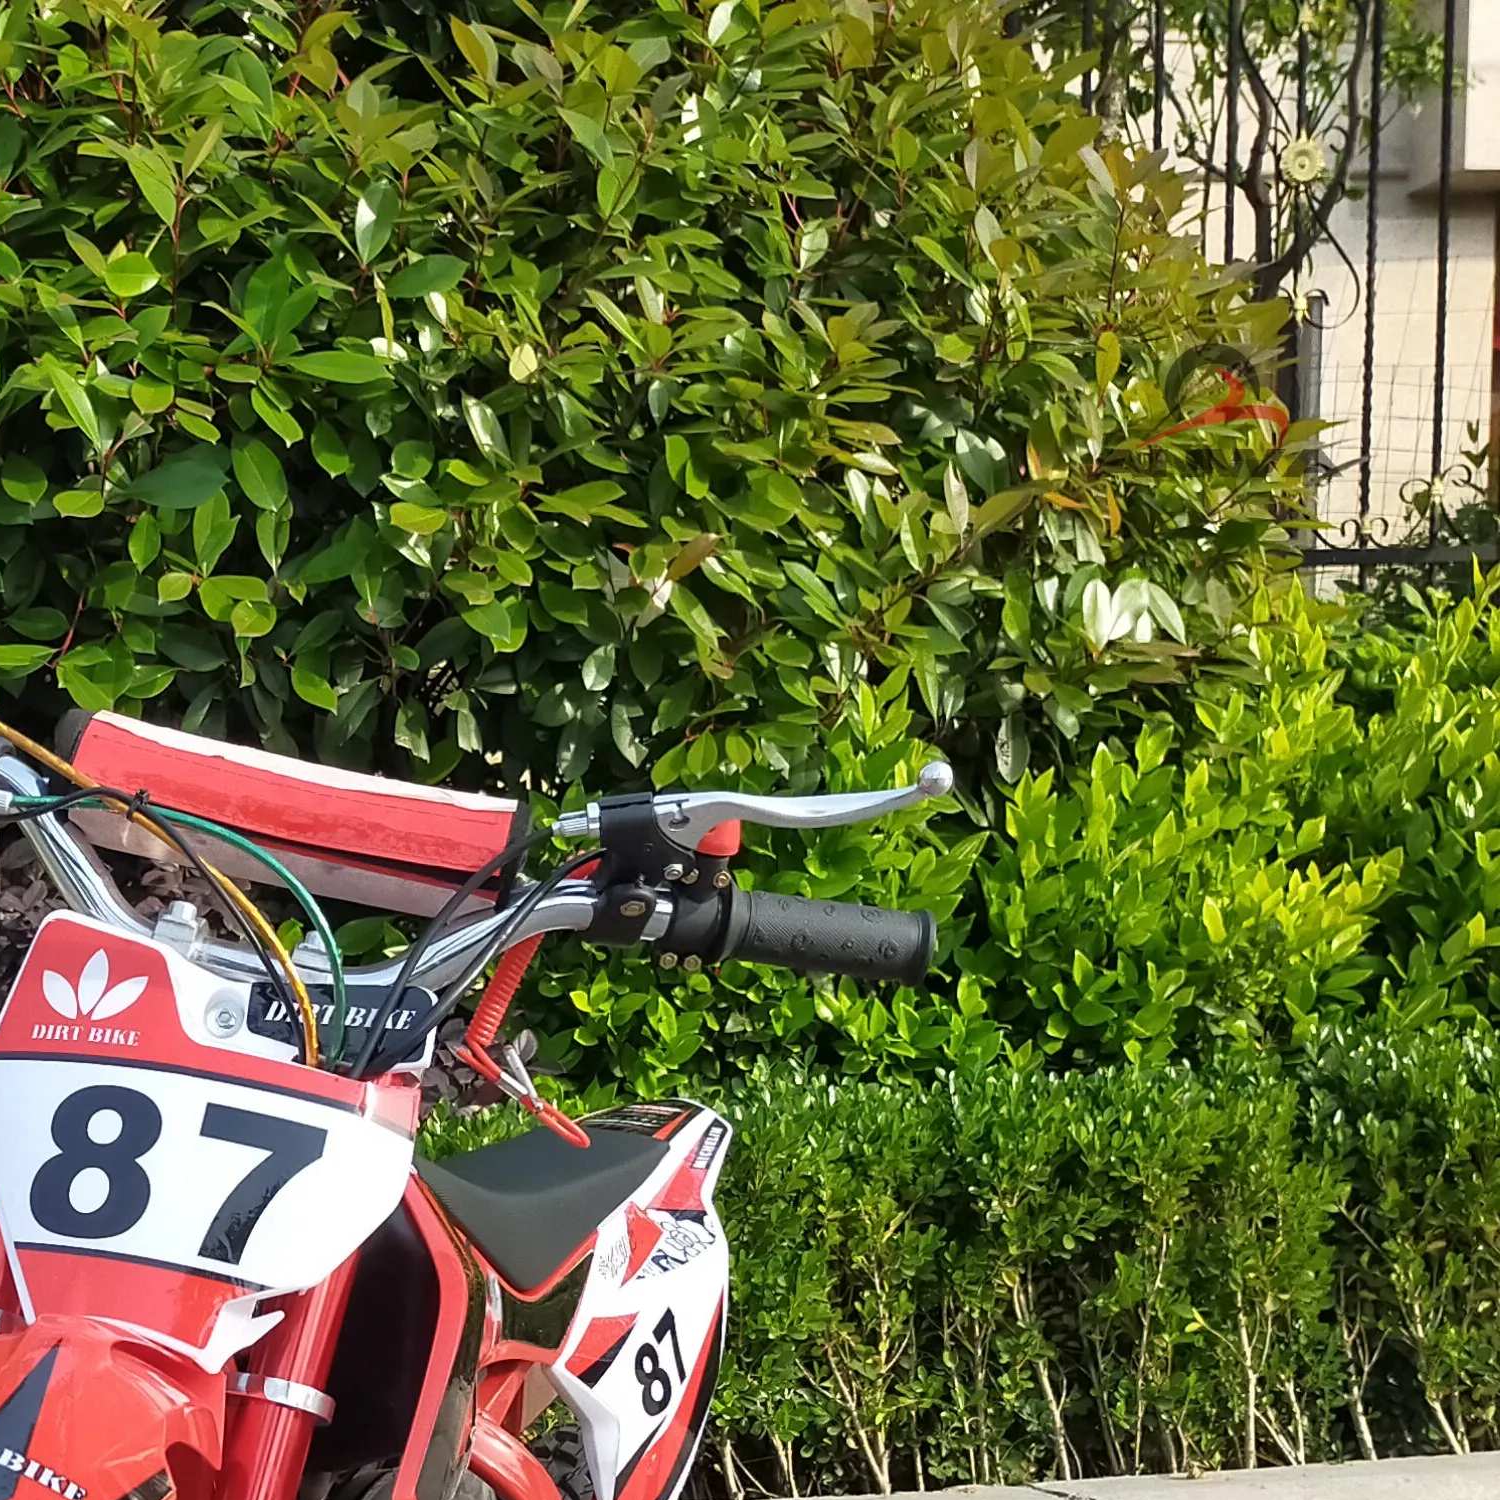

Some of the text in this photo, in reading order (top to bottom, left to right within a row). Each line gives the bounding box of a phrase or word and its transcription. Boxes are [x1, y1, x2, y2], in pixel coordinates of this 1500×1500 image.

[31, 1024, 141, 1046] DIRT BIKE
[29, 1084, 329, 1266] 87
[634, 1306, 687, 1416] 87
